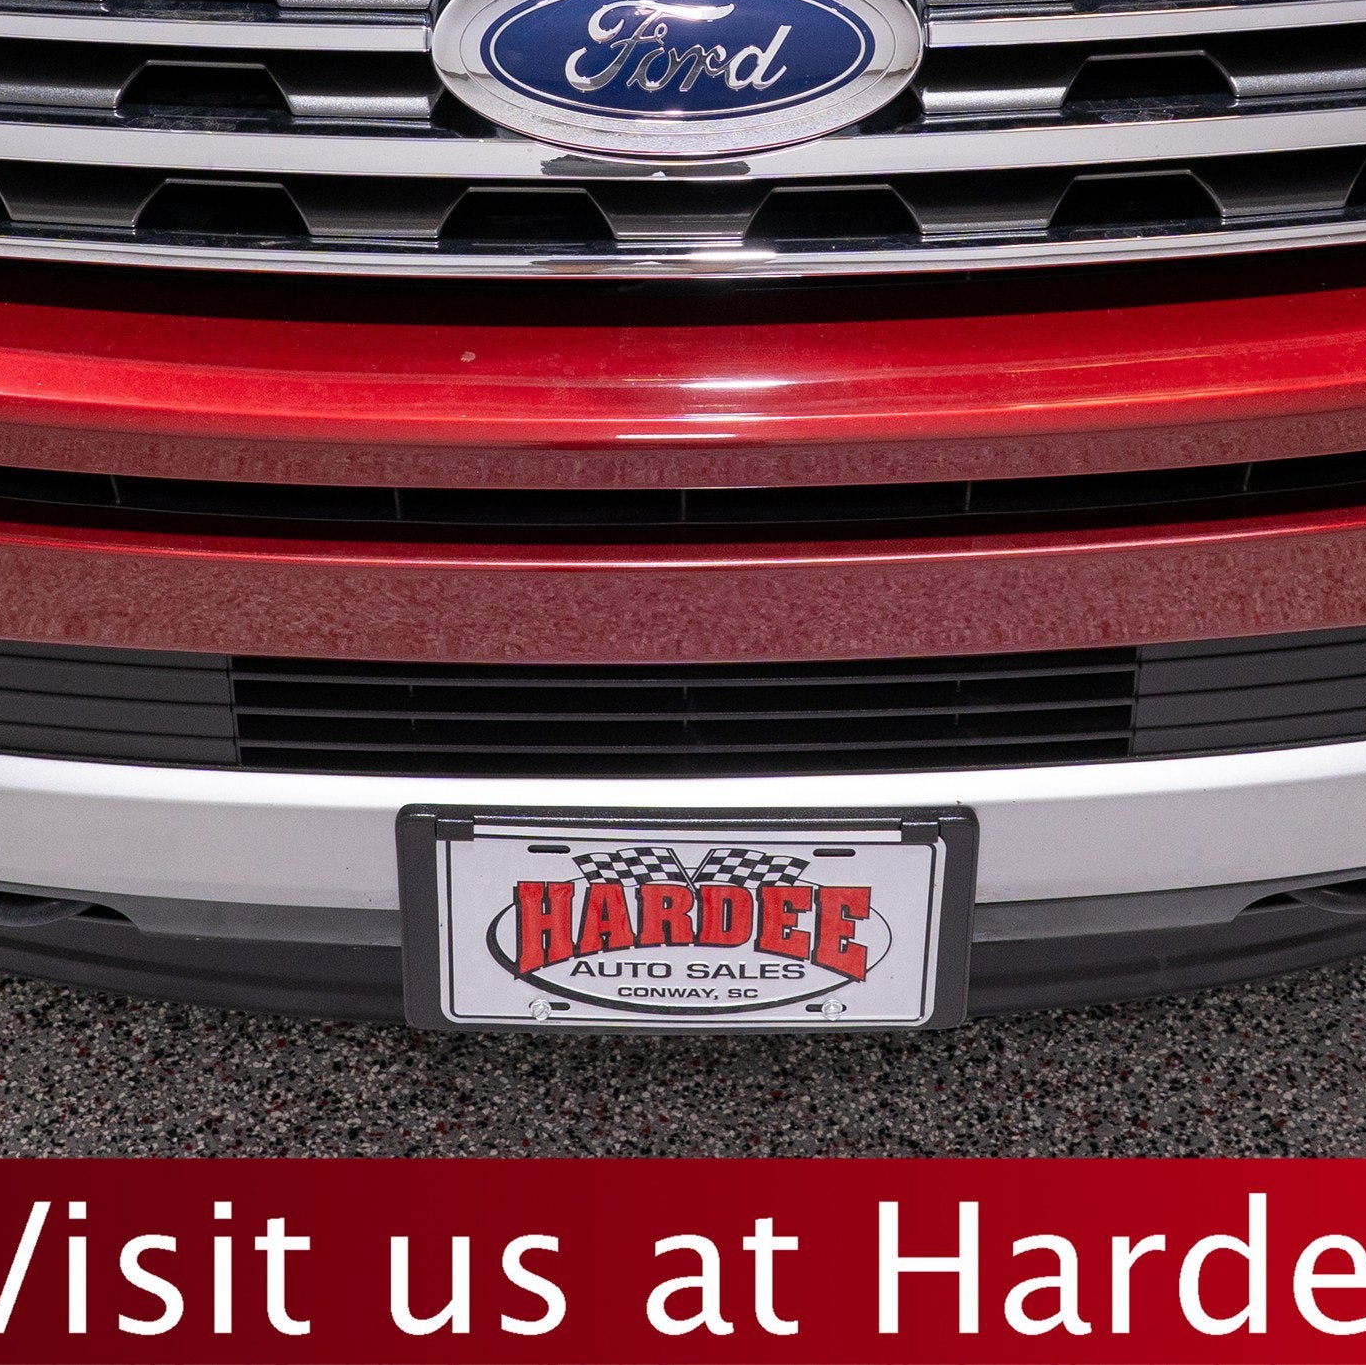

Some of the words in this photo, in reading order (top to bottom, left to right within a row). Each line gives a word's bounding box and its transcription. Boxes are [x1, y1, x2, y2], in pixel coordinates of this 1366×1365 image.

[564, 0, 793, 93] Ford
[513, 881, 872, 982] HARDEE
[569, 960, 674, 979] AUTO
[686, 961, 807, 981] SALES
[617, 985, 720, 1001] CONWAY,
[727, 987, 759, 999] SC
